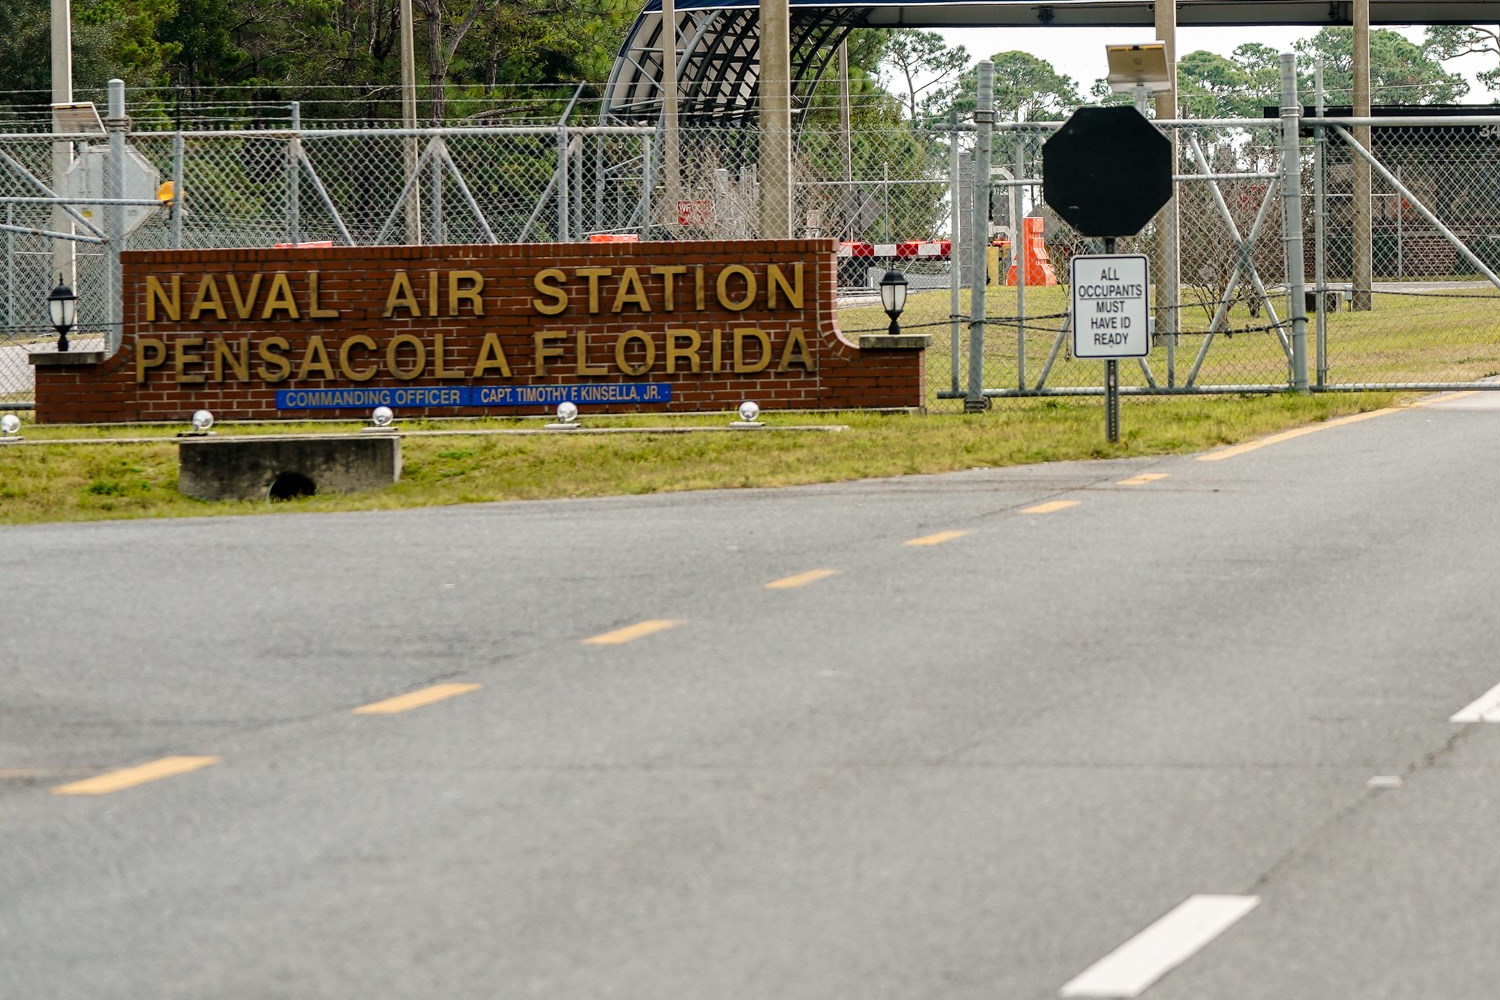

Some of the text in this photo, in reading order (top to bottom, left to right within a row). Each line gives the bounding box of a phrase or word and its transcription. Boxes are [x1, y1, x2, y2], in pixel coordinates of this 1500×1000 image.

[1101, 269, 1120, 281] ALL
[145, 263, 805, 321] NAVAL AIR STATION
[1078, 284, 1143, 298] OCCUPANTS
[1096, 301, 1125, 313] MUST
[1091, 316, 1131, 329] HAVE ID
[1094, 333, 1129, 345] READY
[136, 327, 816, 384] PENSACOLA FLORIDA
[286, 389, 461, 407] COMMANDING OFFICER
[481, 388, 514, 403] CAPT.
[516, 387, 569, 402] TIMOTHY
[581, 385, 641, 402] KINSELLA,
[643, 385, 662, 400] JR.
